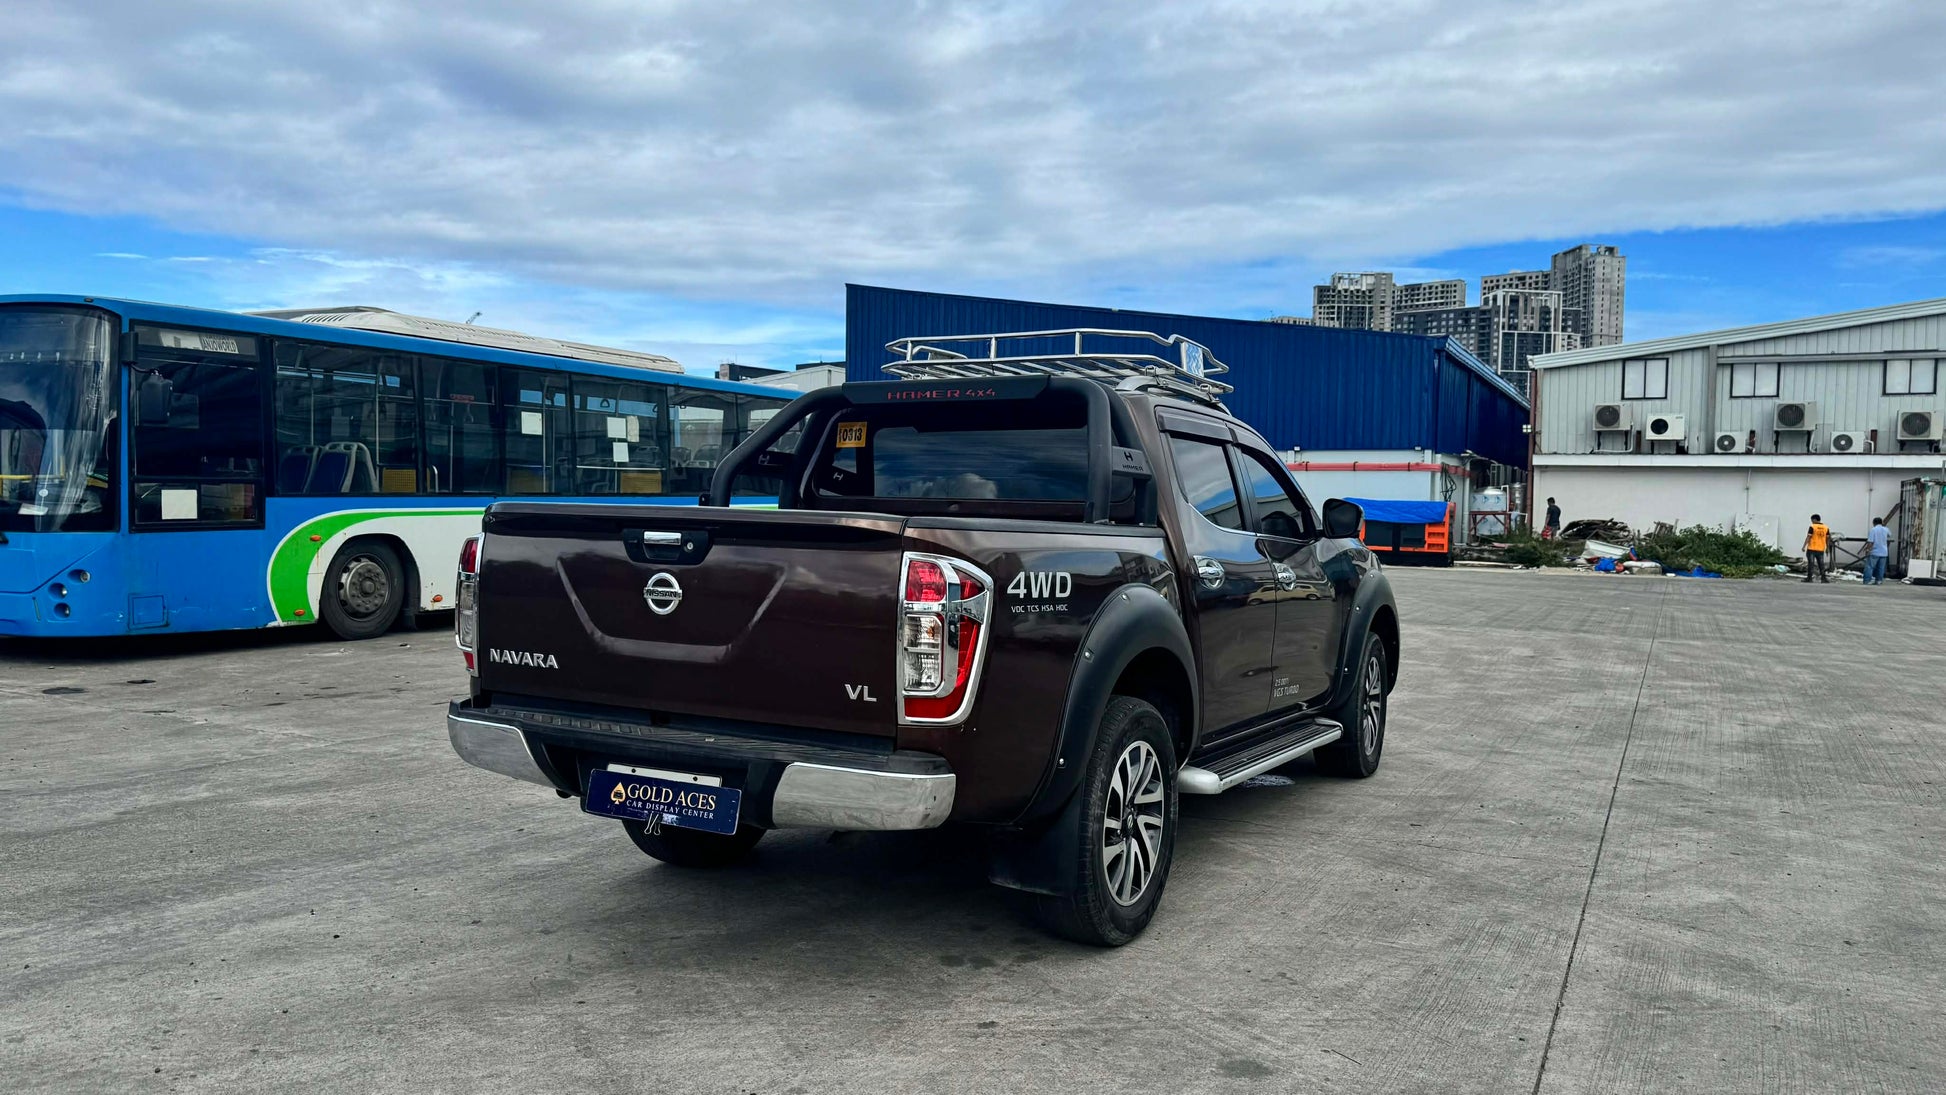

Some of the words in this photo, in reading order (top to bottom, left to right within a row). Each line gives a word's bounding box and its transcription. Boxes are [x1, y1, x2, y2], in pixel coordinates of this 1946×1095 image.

[887, 389, 960, 400] HAMER
[966, 388, 995, 398] 4x4
[842, 428, 862, 441] 0313
[1124, 451, 1134, 461] H
[1006, 571, 1072, 598] 4WD
[646, 589, 677, 598] NISSAN
[1011, 605, 1025, 613] VDC
[1027, 604, 1040, 612] TCS
[489, 648, 559, 669] NAVARA
[844, 684, 877, 702] VL
[627, 783, 673, 803] GOLD
[675, 791, 716, 810] ACES
[626, 800, 643, 808] CAR
[645, 802, 680, 814] DISPLAY
[682, 809, 714, 819] CENTER
